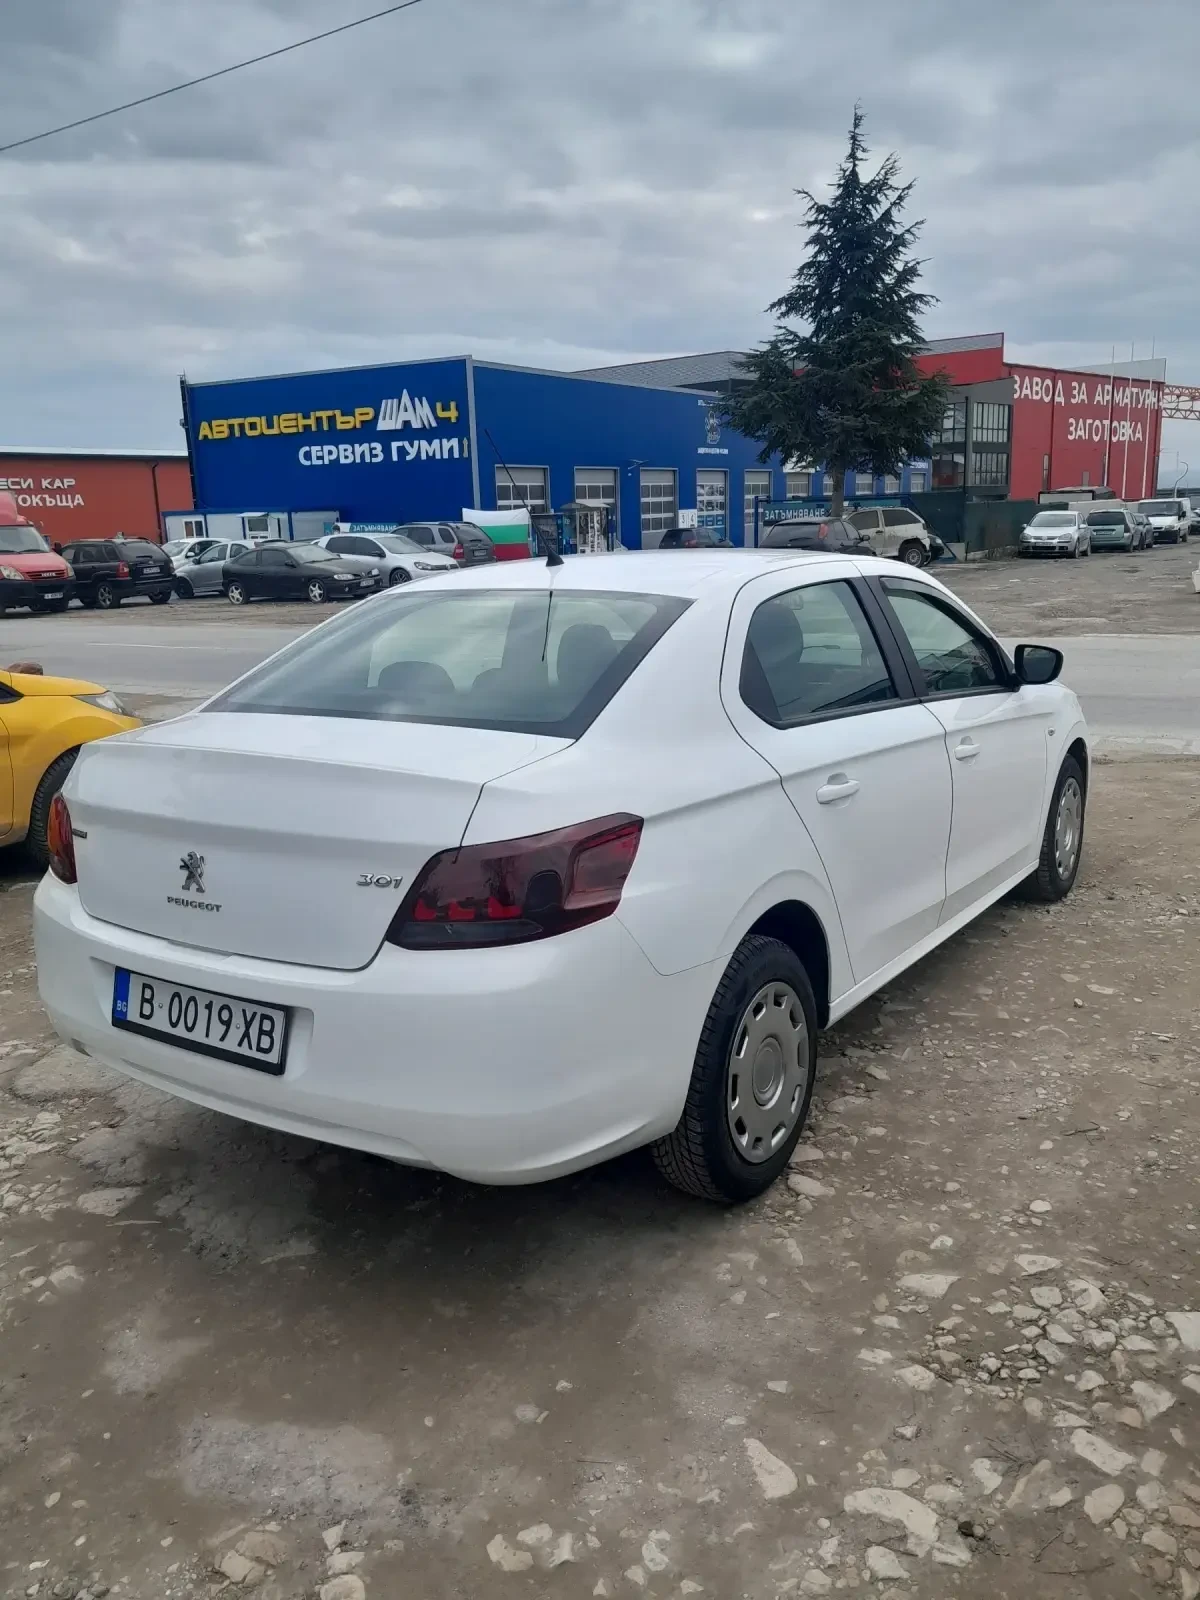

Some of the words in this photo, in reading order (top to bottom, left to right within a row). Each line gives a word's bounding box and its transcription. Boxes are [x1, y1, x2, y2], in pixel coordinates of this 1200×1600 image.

[1013, 375, 1065, 406] ЗАВОД
[1070, 382, 1088, 404] ЗА
[198, 407, 375, 440] АВТОЦЕНТЪР
[376, 388, 437, 431] ШАМ
[1067, 417, 1143, 443] ЗАГОТОВКА
[299, 442, 384, 466] СЕРВИЗ
[391, 438, 459, 462] ГУМИ
[41, 478, 76, 489] КАР
[15, 494, 85, 508] ОКЪЩА
[356, 873, 403, 889] 301
[167, 896, 222, 913] PEUGEOT
[116, 1001, 127, 1012] BG
[168, 991, 233, 1042] 0019
